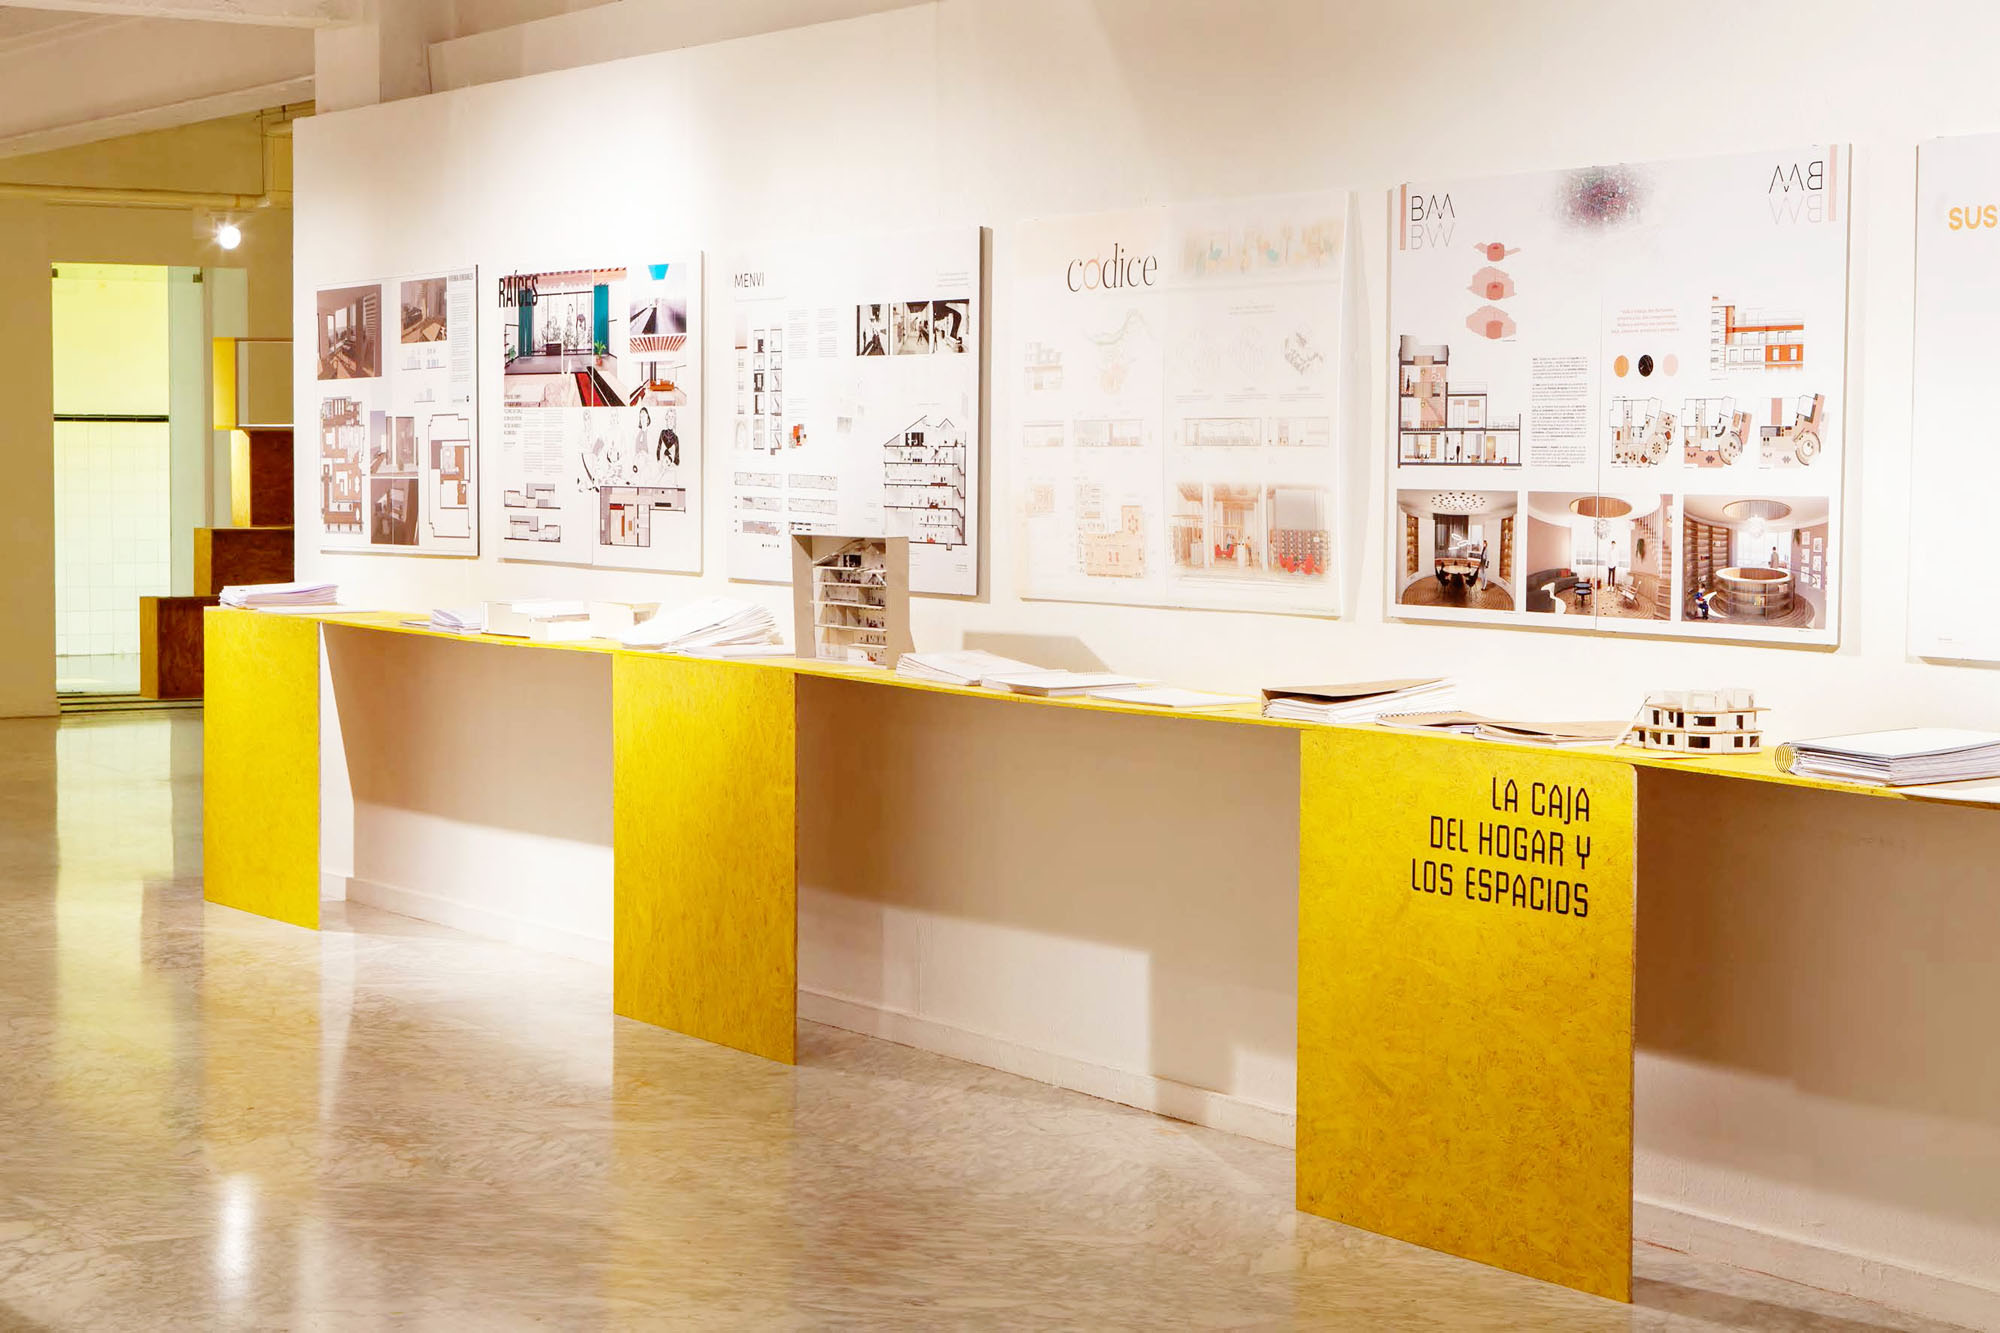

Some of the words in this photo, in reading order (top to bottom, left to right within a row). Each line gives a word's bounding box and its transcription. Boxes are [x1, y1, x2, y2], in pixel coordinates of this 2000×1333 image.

[498, 269, 539, 308] RAÍCES
[734, 271, 765, 289] MENVI
[1492, 776, 1518, 813] LA
[1531, 781, 1590, 825] CAJA
[1430, 815, 1469, 853] DEL
[1479, 821, 1564, 867] HOGAR
[1576, 834, 1591, 870] Y
[1412, 858, 1453, 896] LOS
[1466, 866, 1588, 918] ESPACIOS
